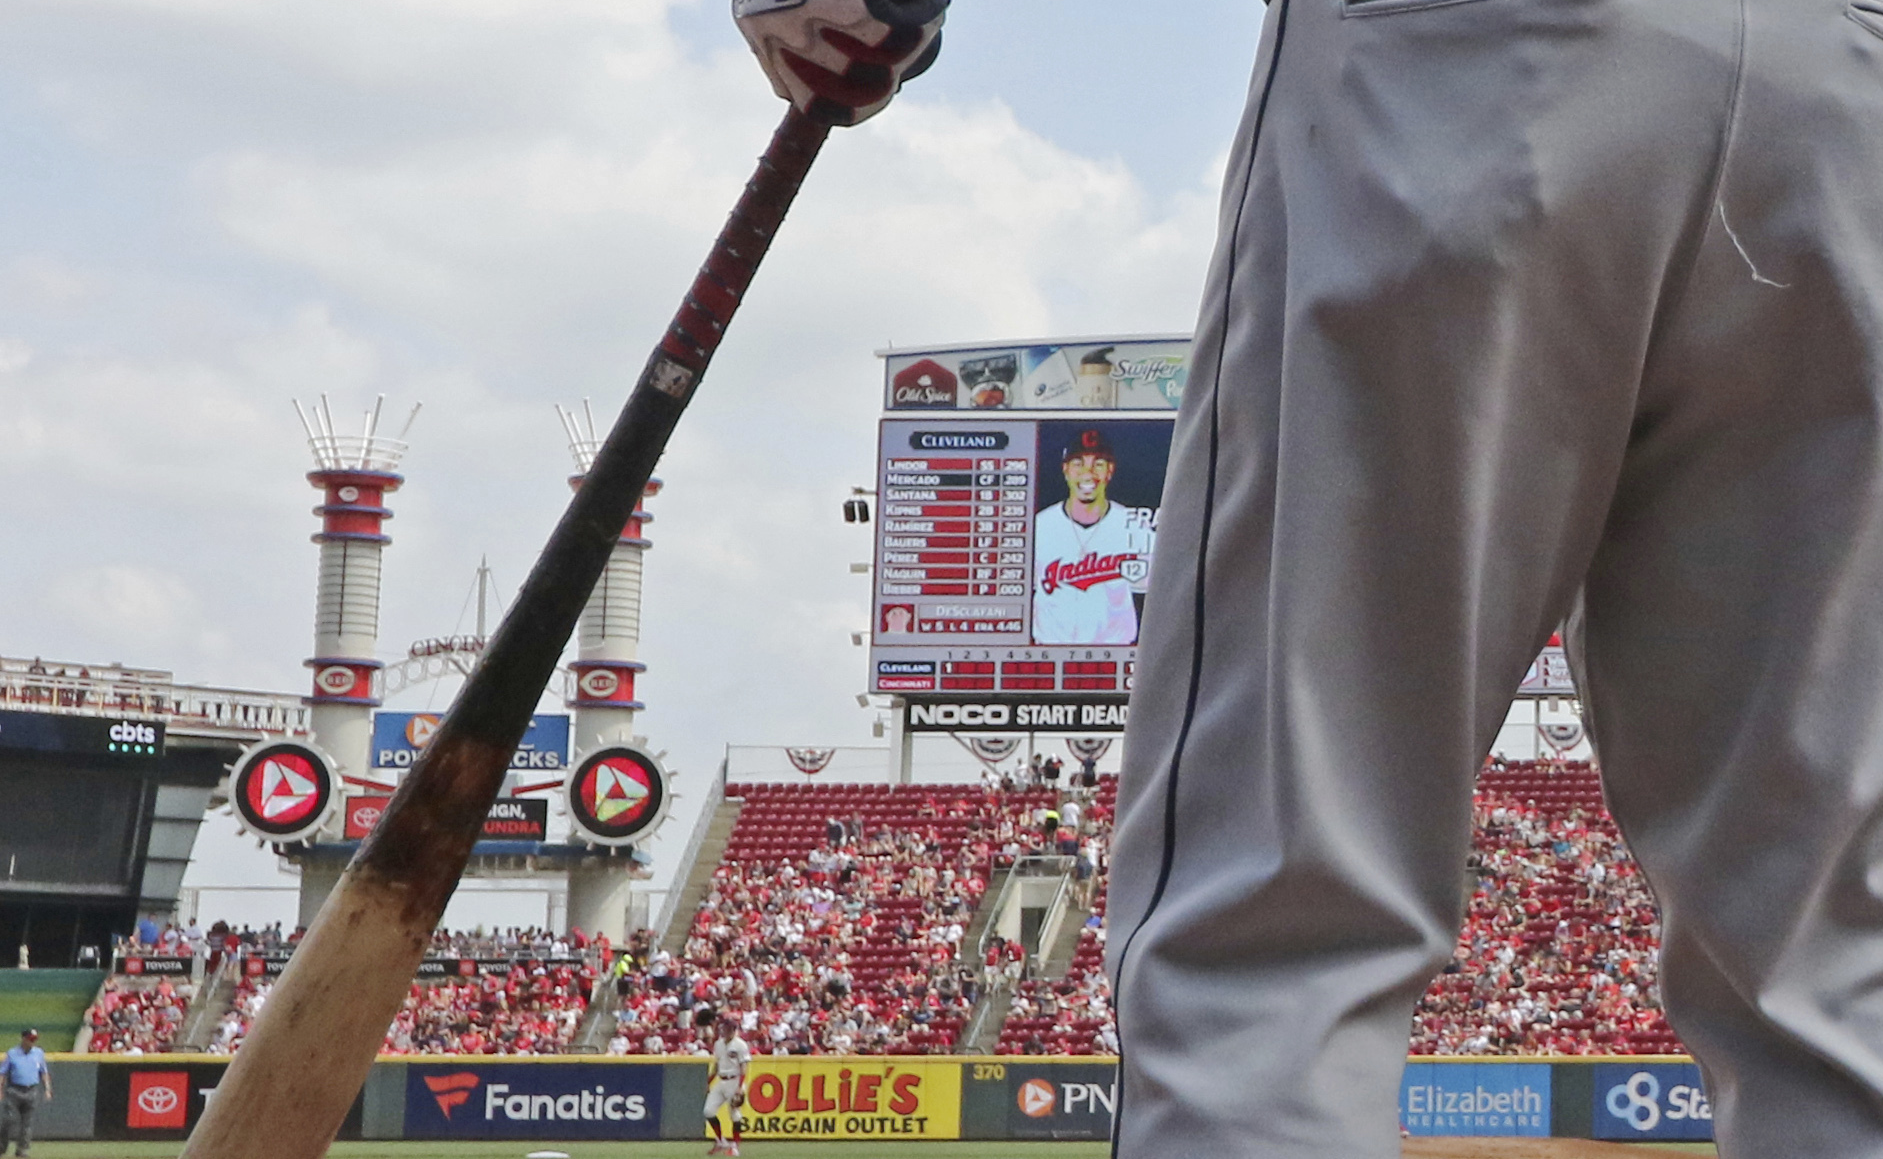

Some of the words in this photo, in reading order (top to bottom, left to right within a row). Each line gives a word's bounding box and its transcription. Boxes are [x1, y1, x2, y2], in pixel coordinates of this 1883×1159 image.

[896, 386, 920, 402] Old
[925, 386, 952, 404] Spice
[921, 434, 997, 448] CLEVELAND
[1126, 563, 1141, 577] 12
[411, 634, 486, 656] CINCIN
[963, 651, 971, 660] 2
[982, 651, 990, 660] 3
[1007, 651, 1014, 660] 4
[910, 704, 1010, 726] NOCO
[1016, 705, 1077, 726] START
[109, 720, 156, 743] cbts
[488, 804, 526, 819] IGN,
[484, 820, 542, 834] UNDRA
[144, 960, 183, 972] TOYOTA
[972, 1064, 1006, 1080] 370
[485, 1083, 646, 1121] Fanatics
[1062, 1084, 1116, 1114] PN
[1407, 1085, 1541, 1114] Elizabeth
[1665, 1085, 1714, 1120] Sta
[740, 1116, 835, 1133] BARGAIN
[845, 1116, 928, 1134] OUTLET
[1408, 1116, 1541, 1127] HEALTHCARE
